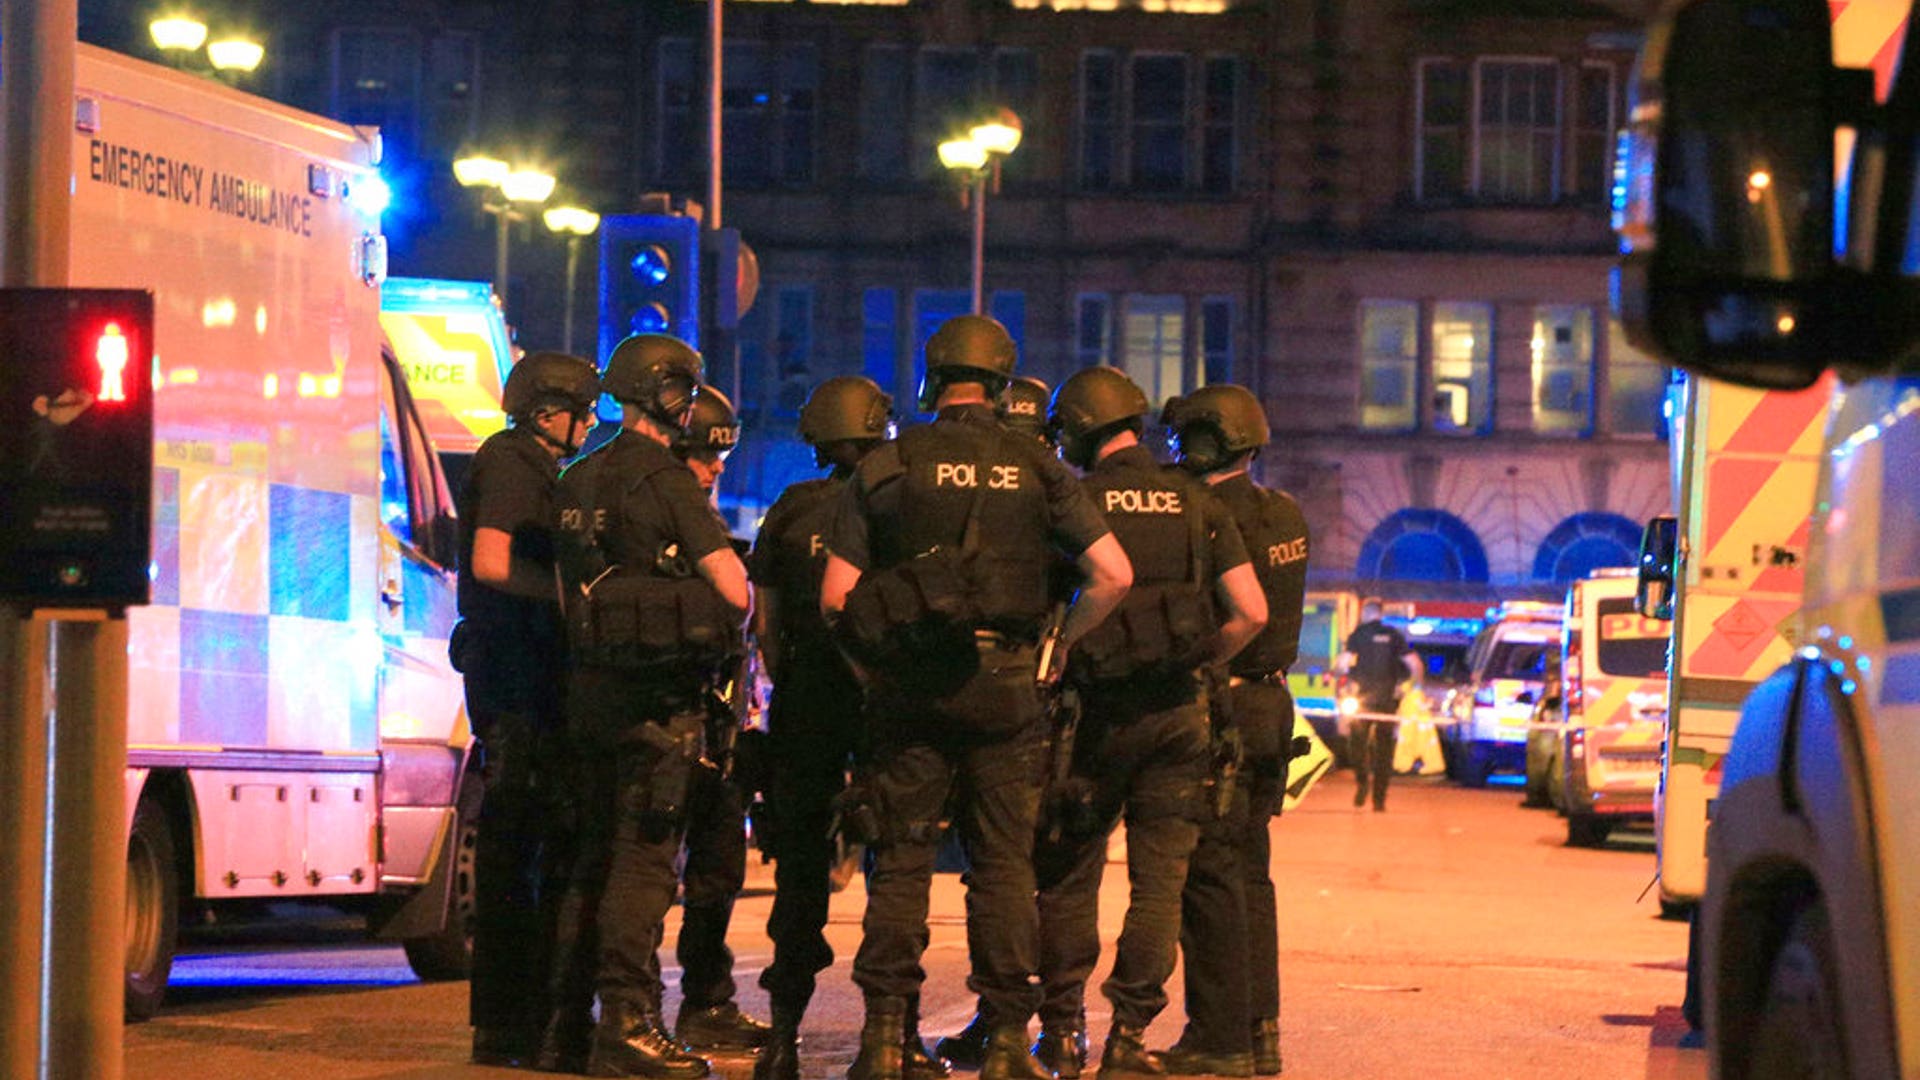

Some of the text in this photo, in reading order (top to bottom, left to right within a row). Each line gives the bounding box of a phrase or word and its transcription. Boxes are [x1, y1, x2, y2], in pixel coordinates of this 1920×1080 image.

[90, 139, 311, 238] EMERGENCY AMBULANCE
[1008, 401, 1036, 415] LICE
[710, 426, 740, 445] POL
[937, 463, 1019, 490] POLCE
[1105, 489, 1182, 514] POLICE
[1269, 536, 1306, 567] POLICE
[1602, 616, 1669, 639] PO
